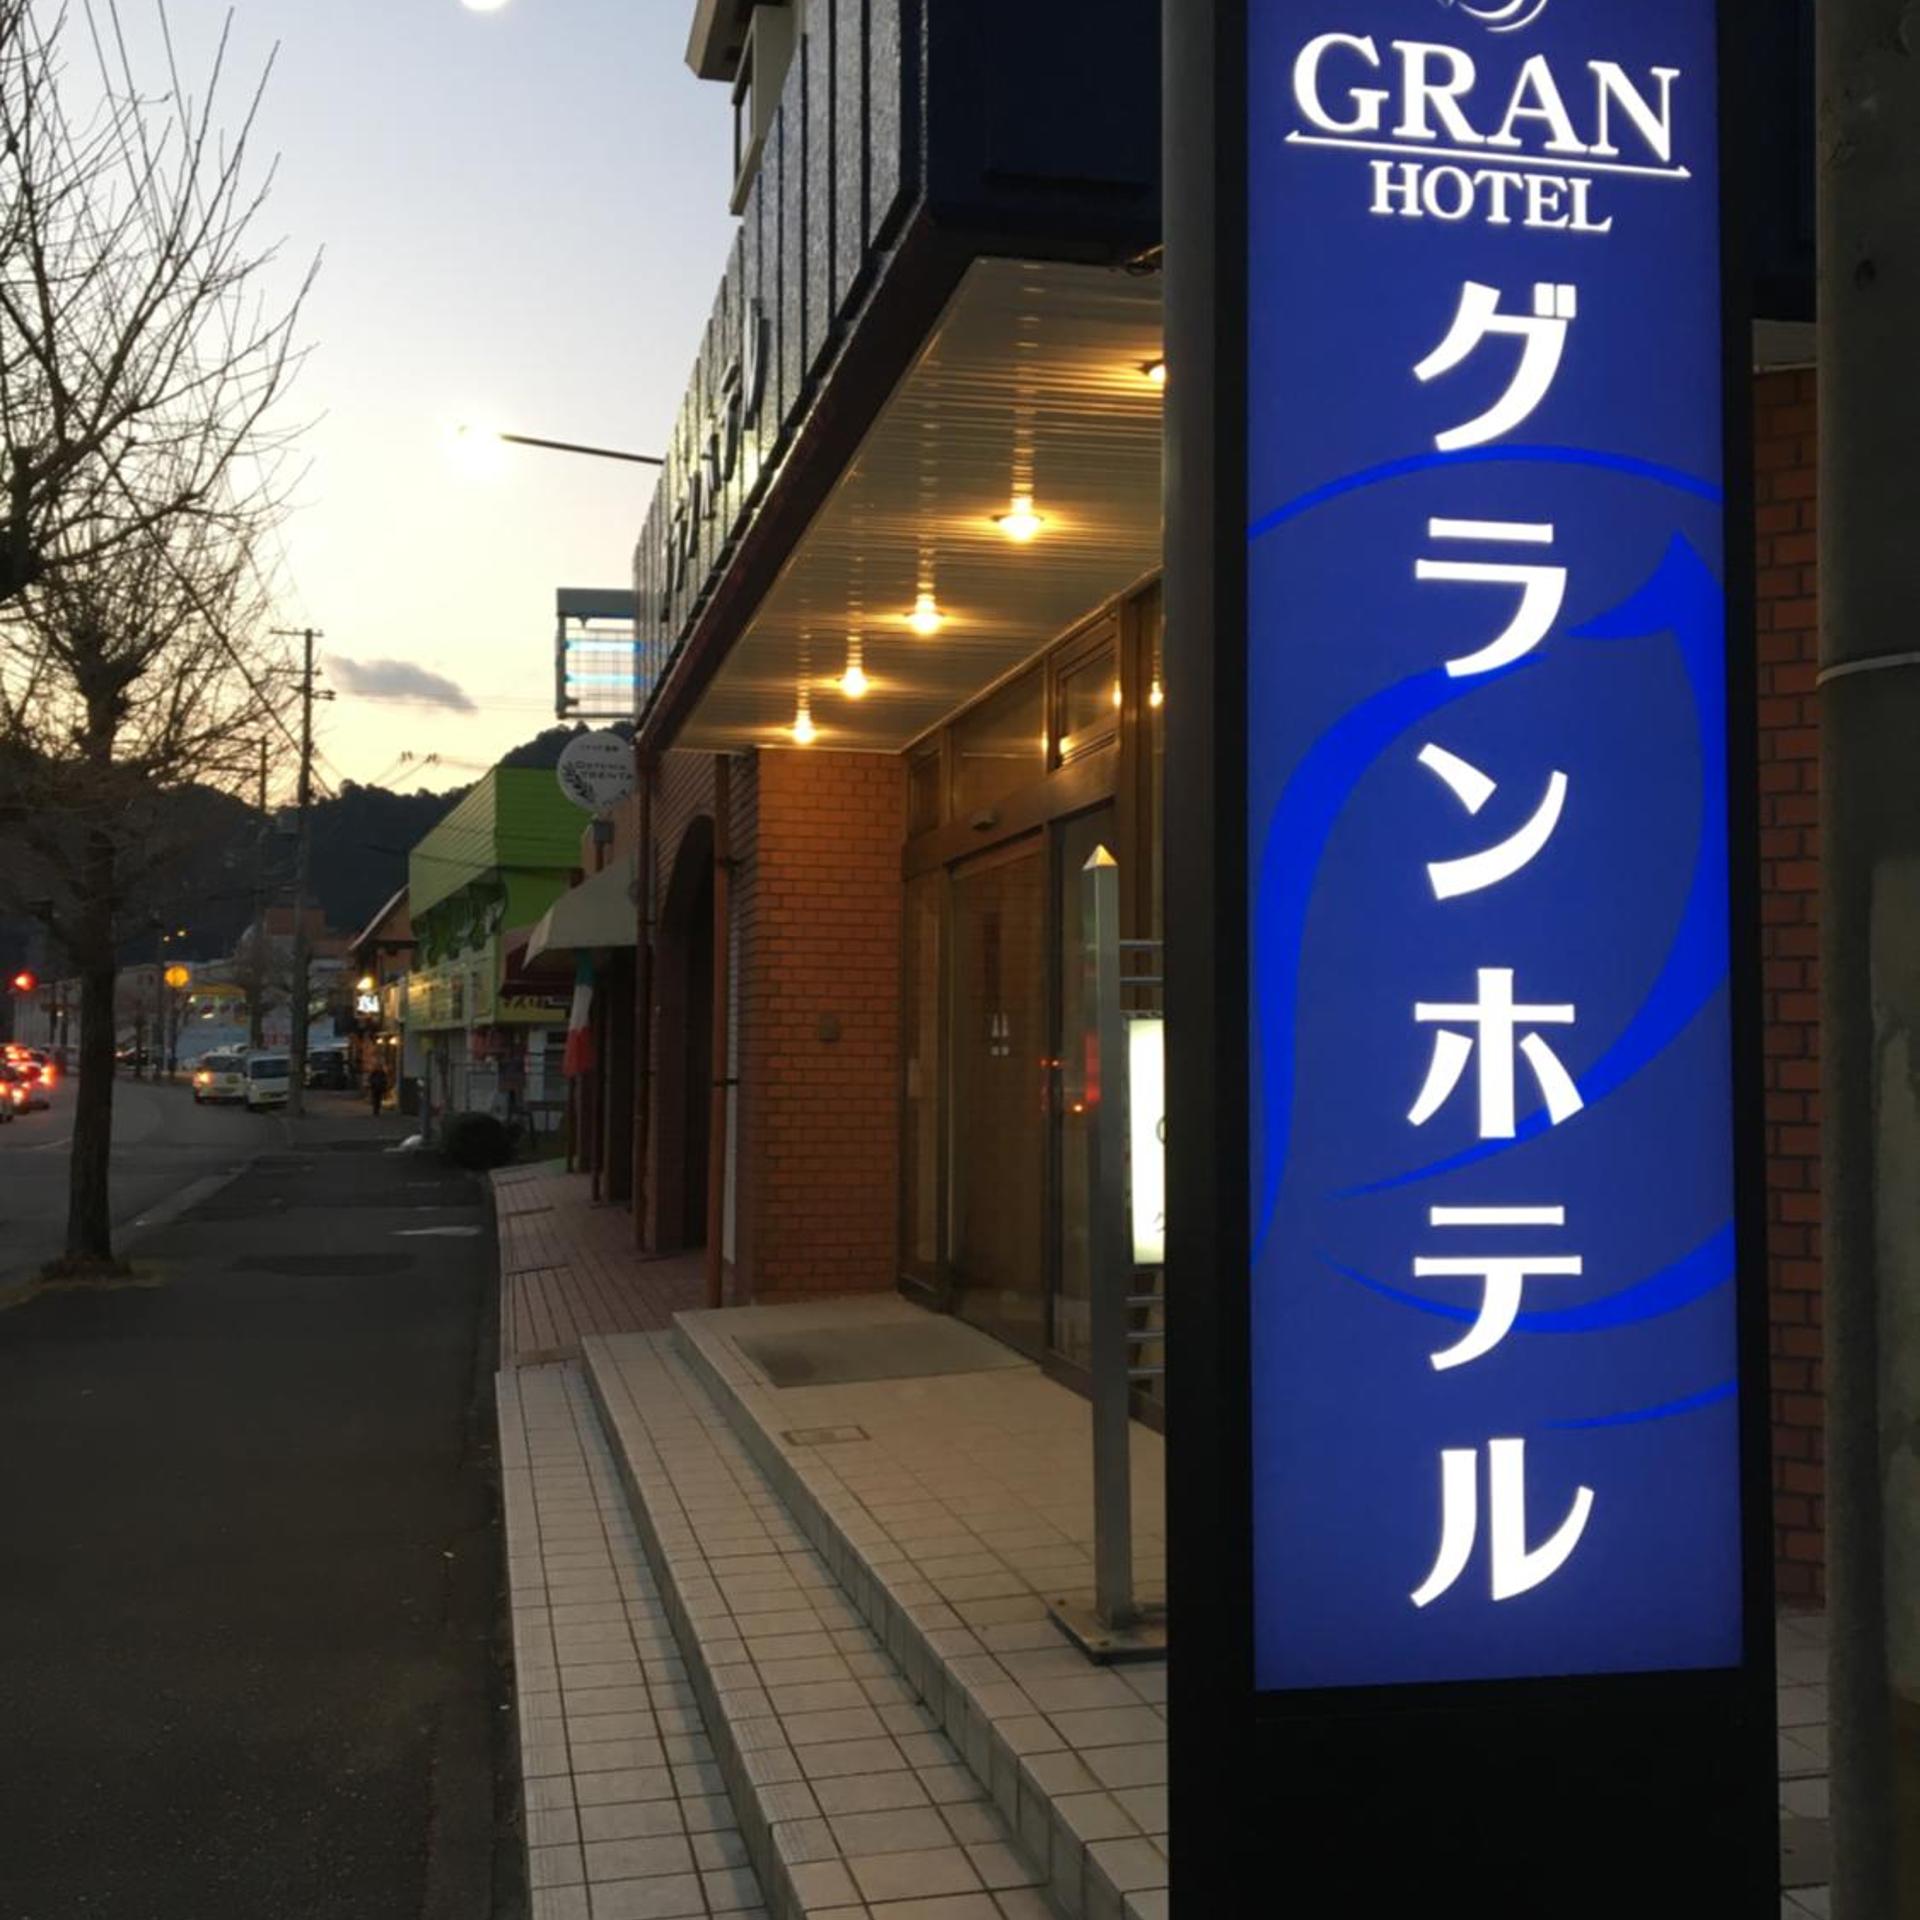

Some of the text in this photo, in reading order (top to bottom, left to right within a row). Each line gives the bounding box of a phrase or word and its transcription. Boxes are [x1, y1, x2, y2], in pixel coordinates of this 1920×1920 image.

[1293, 32, 1680, 163] GRAN
[1370, 160, 1612, 233] HOTEL
[1407, 280, 1596, 1607] グランホテル
